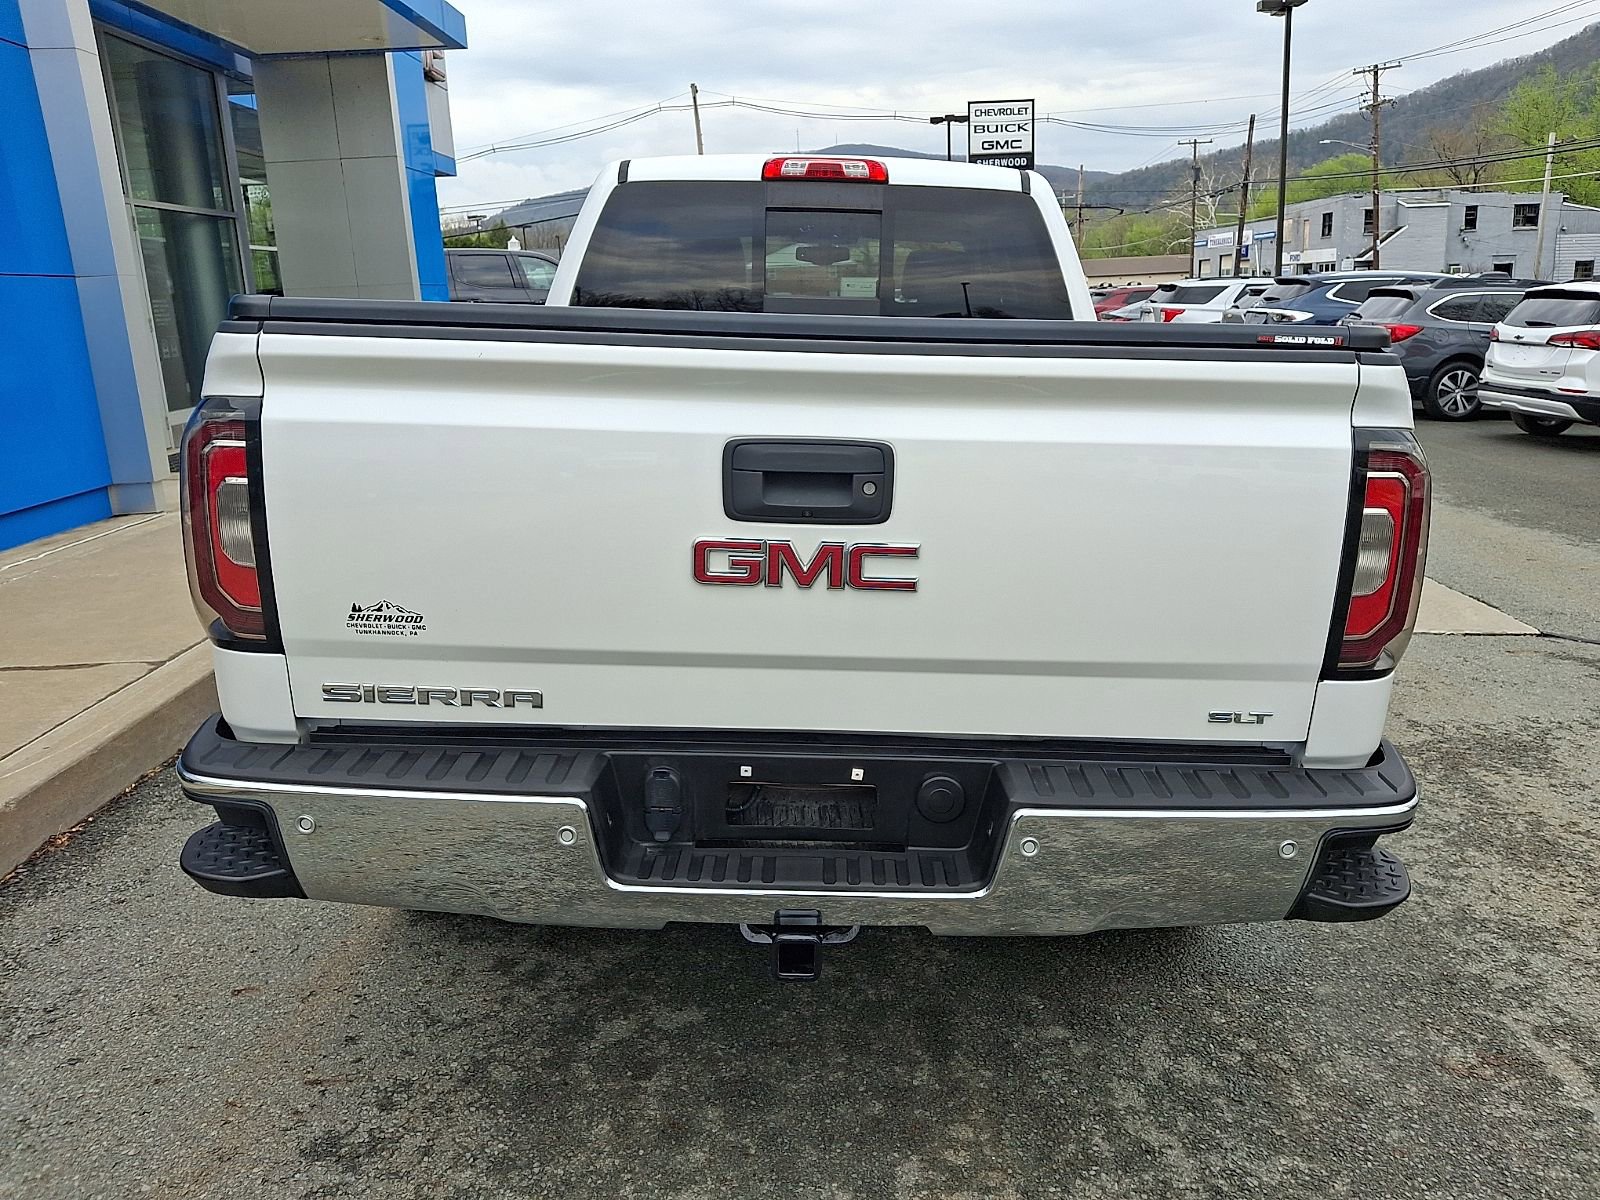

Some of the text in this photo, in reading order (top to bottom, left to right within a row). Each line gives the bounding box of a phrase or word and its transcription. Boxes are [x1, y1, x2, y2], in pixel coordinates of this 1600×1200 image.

[974, 107, 1029, 117] CHEVROLET
[974, 122, 1029, 133] BUICK
[982, 139, 1022, 150] GMC
[1274, 335, 1306, 344] SOLID
[1307, 336, 1334, 345] FOLD
[691, 536, 921, 592] GMC
[347, 613, 424, 624] SHERWOOD
[321, 682, 543, 709] SIERRA
[1208, 710, 1274, 724] SLT
